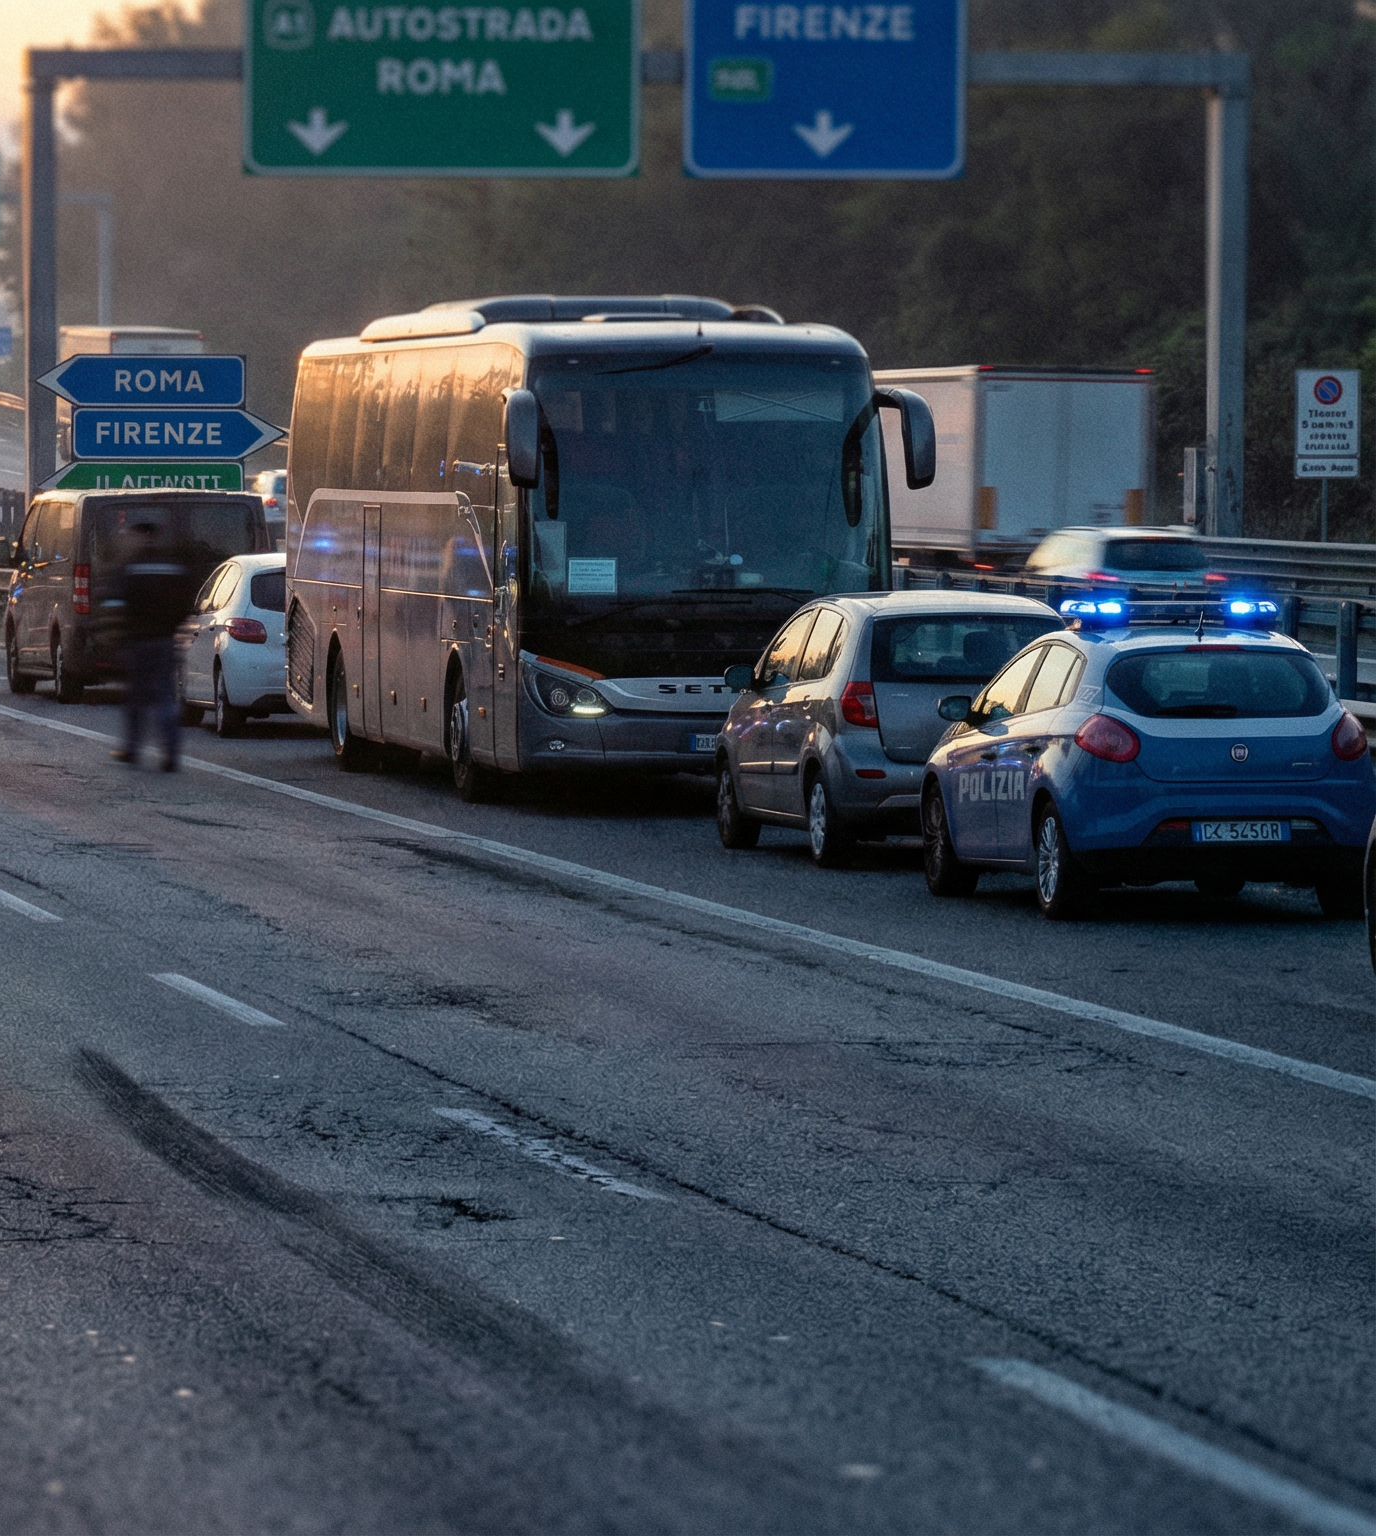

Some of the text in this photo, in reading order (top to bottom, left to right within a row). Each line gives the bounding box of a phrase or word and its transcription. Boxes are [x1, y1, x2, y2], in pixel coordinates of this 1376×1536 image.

[326, 6, 593, 42] AUTOSTRADA
[735, 4, 914, 41] FIRENZE
[377, 57, 507, 95] ROMA
[114, 369, 205, 393] ROMA
[96, 421, 222, 445] FIRENZE
[658, 684, 741, 694] SET
[958, 770, 1025, 803] POLIZIA
